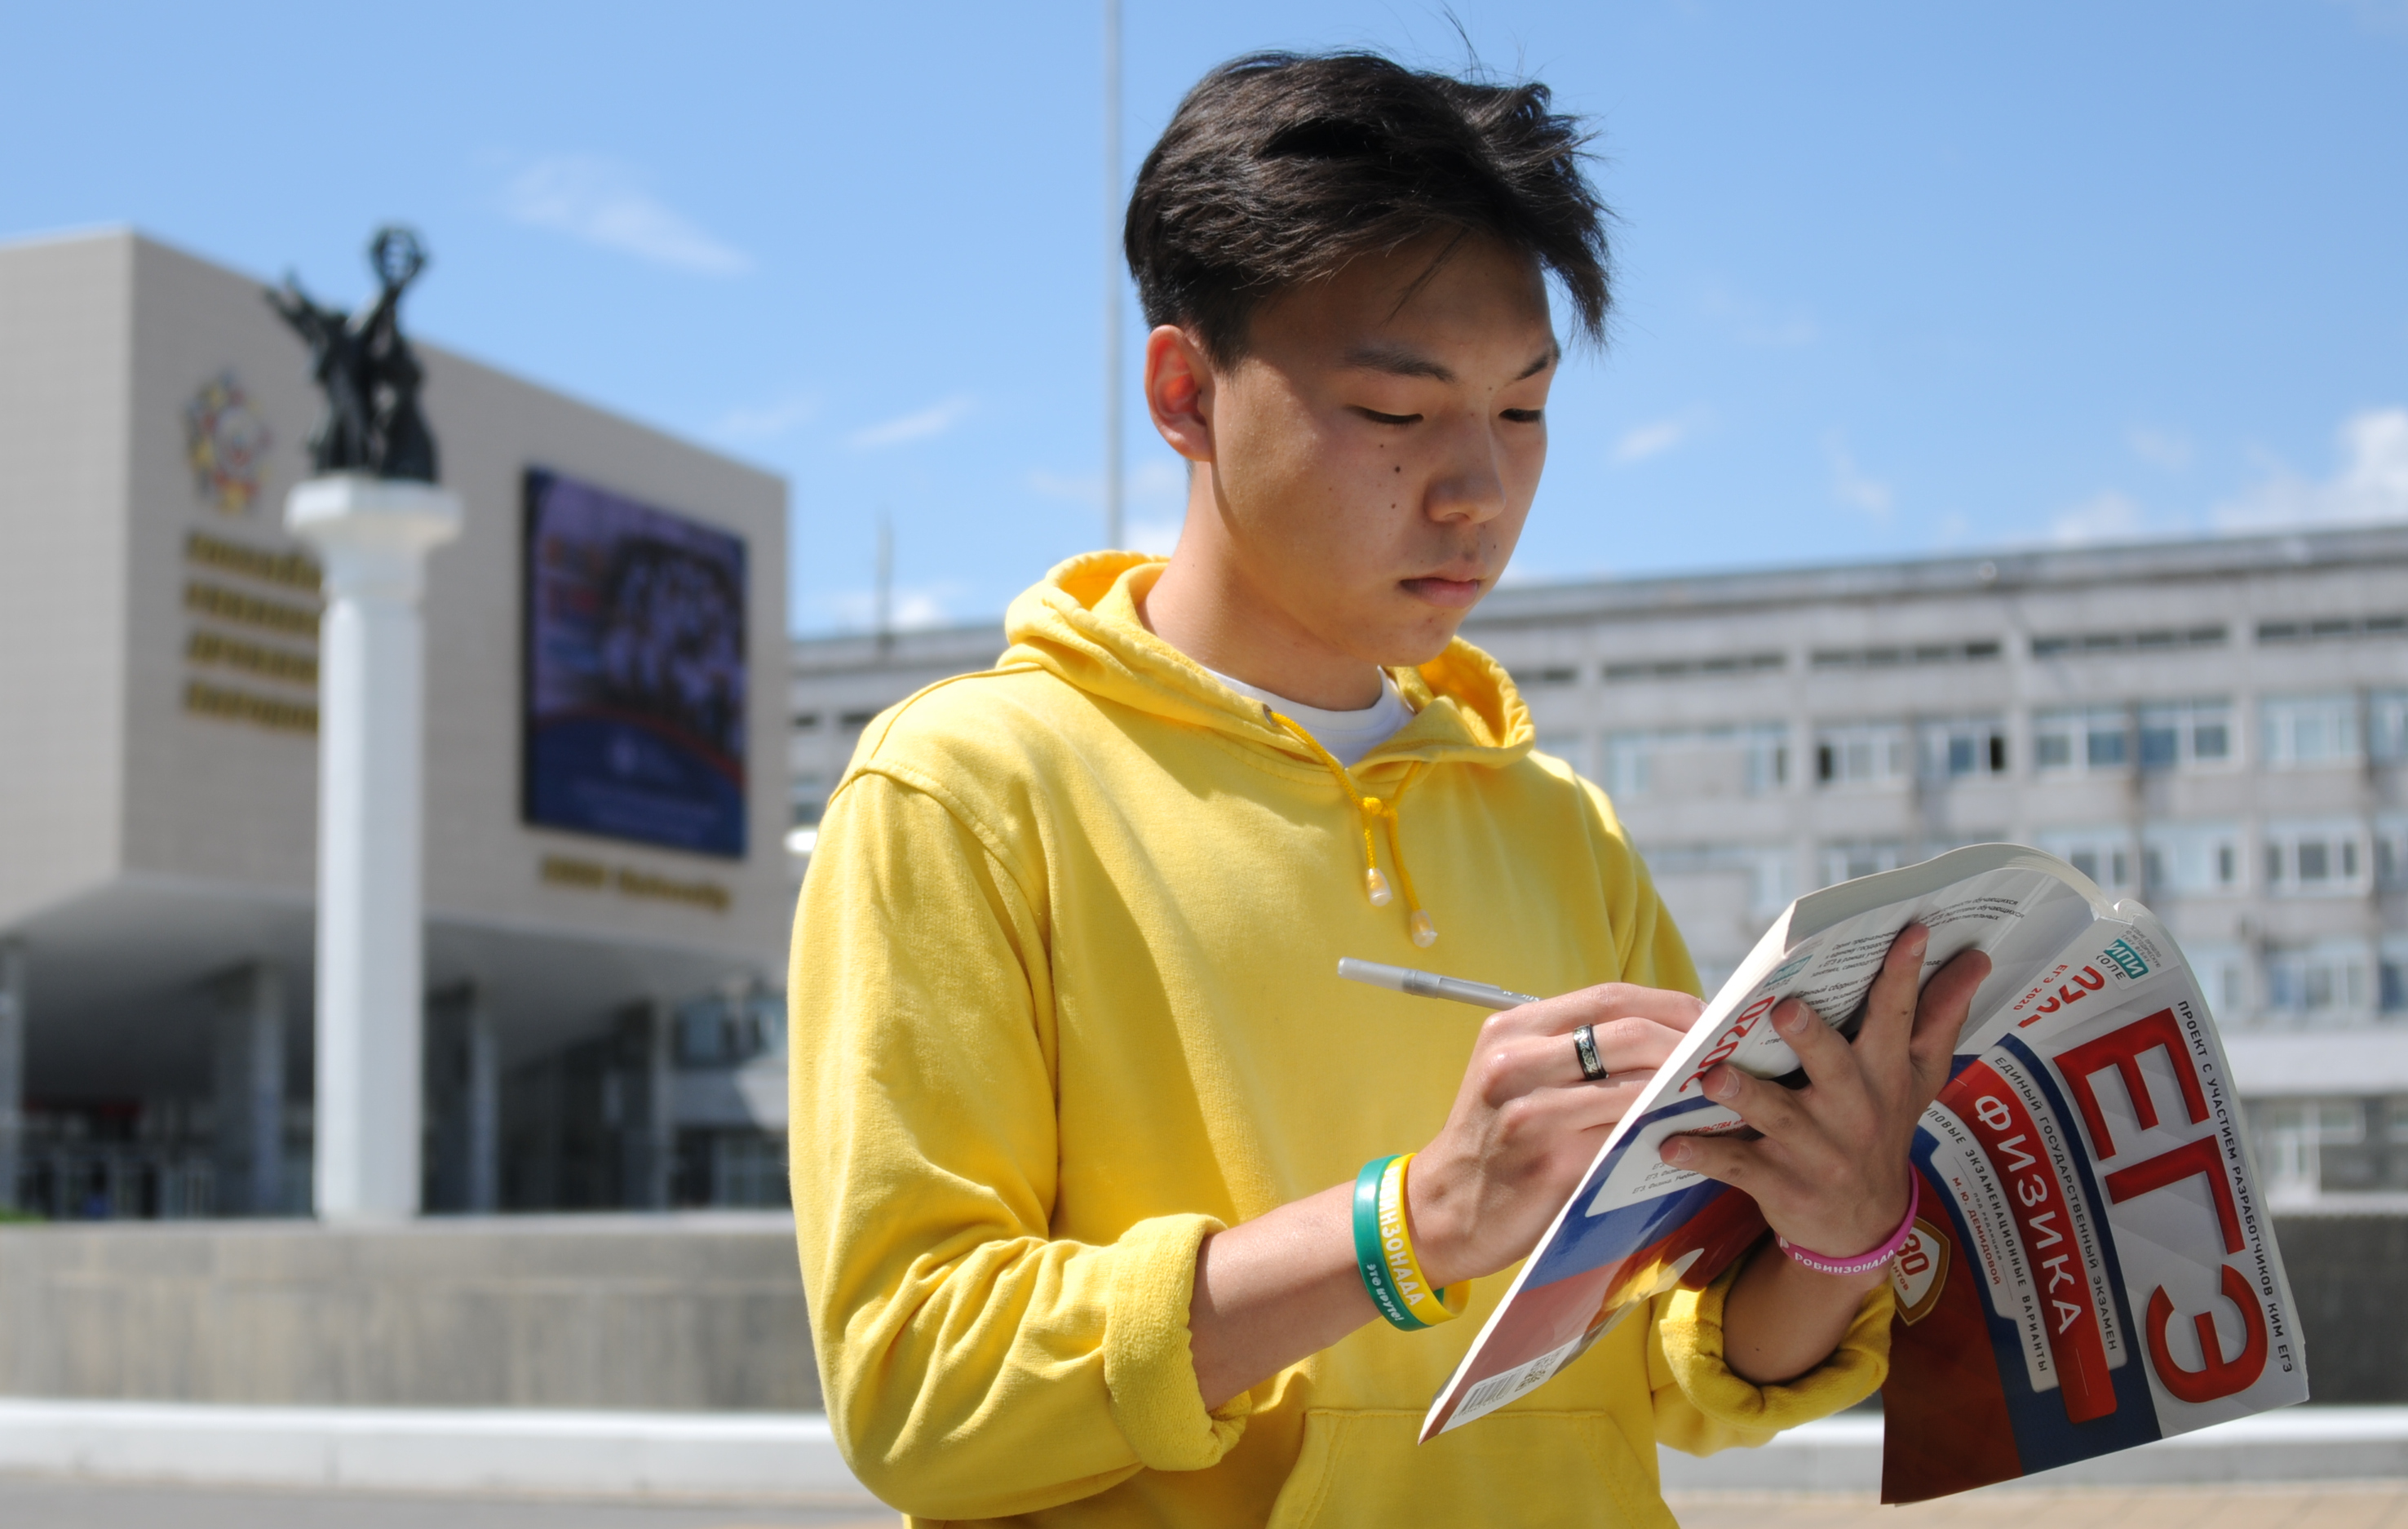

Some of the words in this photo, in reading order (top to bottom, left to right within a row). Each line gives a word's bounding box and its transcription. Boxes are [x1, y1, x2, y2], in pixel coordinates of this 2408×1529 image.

[2013, 987, 2042, 1010] 2020
[2043, 964, 2068, 983] ЕГЭ
[1973, 1192, 1983, 1209] ПОД
[1982, 1212, 2002, 1261] РЕДАКЦИЕЙ
[1975, 1095, 2082, 1335] ФИЗИКА
[1994, 1057, 2043, 1111] ЕДИНЫЙ
[2039, 1116, 2100, 1269] ГОСУДАРСТВЕННЫЙ
[2093, 1275, 2117, 1350] ЭКЗАМЕН
[2052, 1007, 2269, 1403] ЕГЭ
[2178, 1000, 2207, 1056] ПРОЕКТ
[2202, 1063, 2212, 1073] С
[2207, 1078, 2237, 1159] УЧАСТИЕМ
[2233, 1166, 2273, 1296] РАЗРАБОТЧИКОВ
[2267, 1302, 2283, 1337] КИМ
[2277, 1344, 2292, 1372] ЕГЭ
[1366, 1264, 1381, 1286] ЭТО
[1795, 1249, 1894, 1274] РОБИНЗОНАДА
[1897, 1234, 1930, 1276] 30
[1952, 1177, 1962, 1190] М.
[1960, 1191, 1969, 1205] Ю.
[1968, 1209, 2001, 1285] ДЕМИДОВОЙ
[1965, 1149, 2026, 1287] ЭКЗАМЕНАЦИОННЫЕ
[2022, 1295, 2047, 1372] ВАРИАНТЫ
